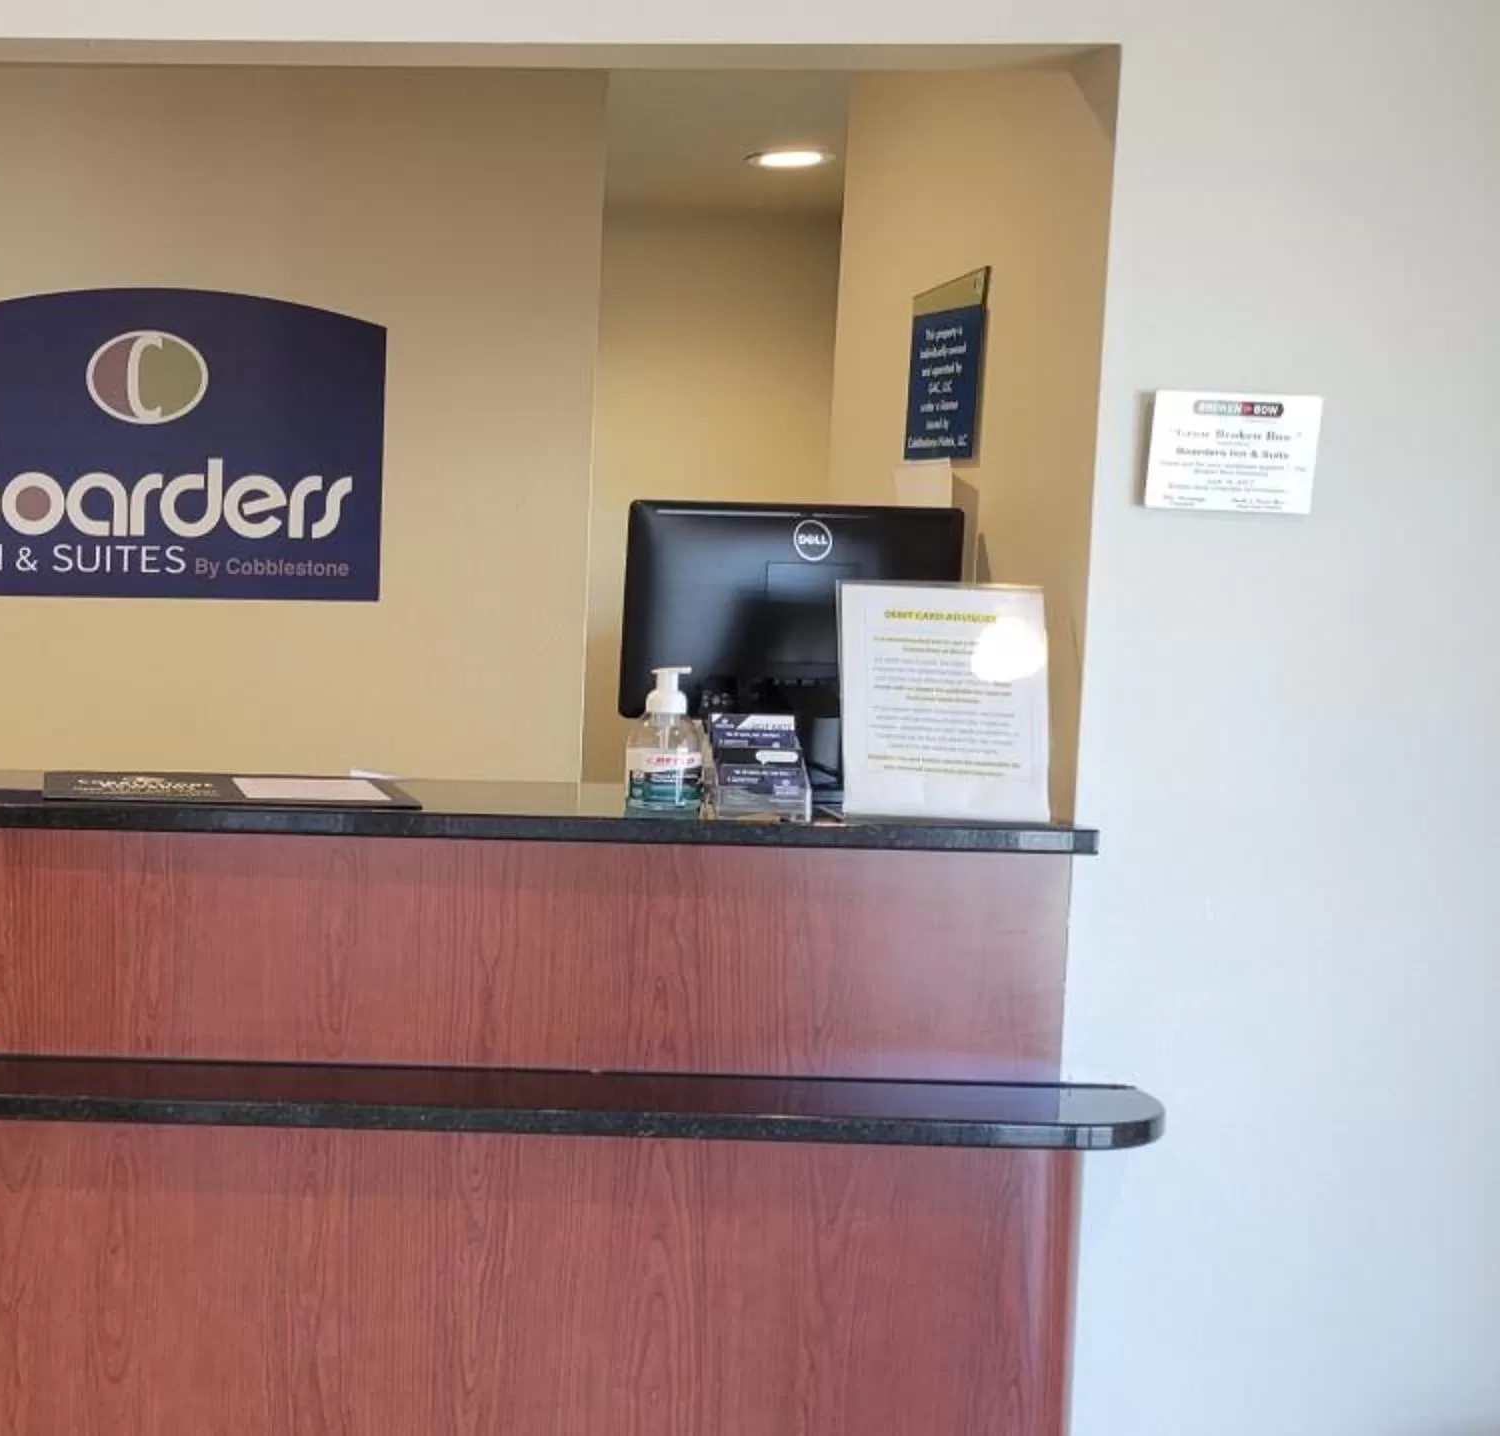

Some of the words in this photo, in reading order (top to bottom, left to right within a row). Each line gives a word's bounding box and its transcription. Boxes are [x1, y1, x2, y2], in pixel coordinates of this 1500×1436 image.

[1253, 402, 1279, 416] BOW
[798, 534, 828, 547] DELL
[15, 544, 39, 573] &
[52, 543, 186, 574] SUITES
[195, 557, 220, 580] By
[226, 557, 350, 578] Cobblestone
